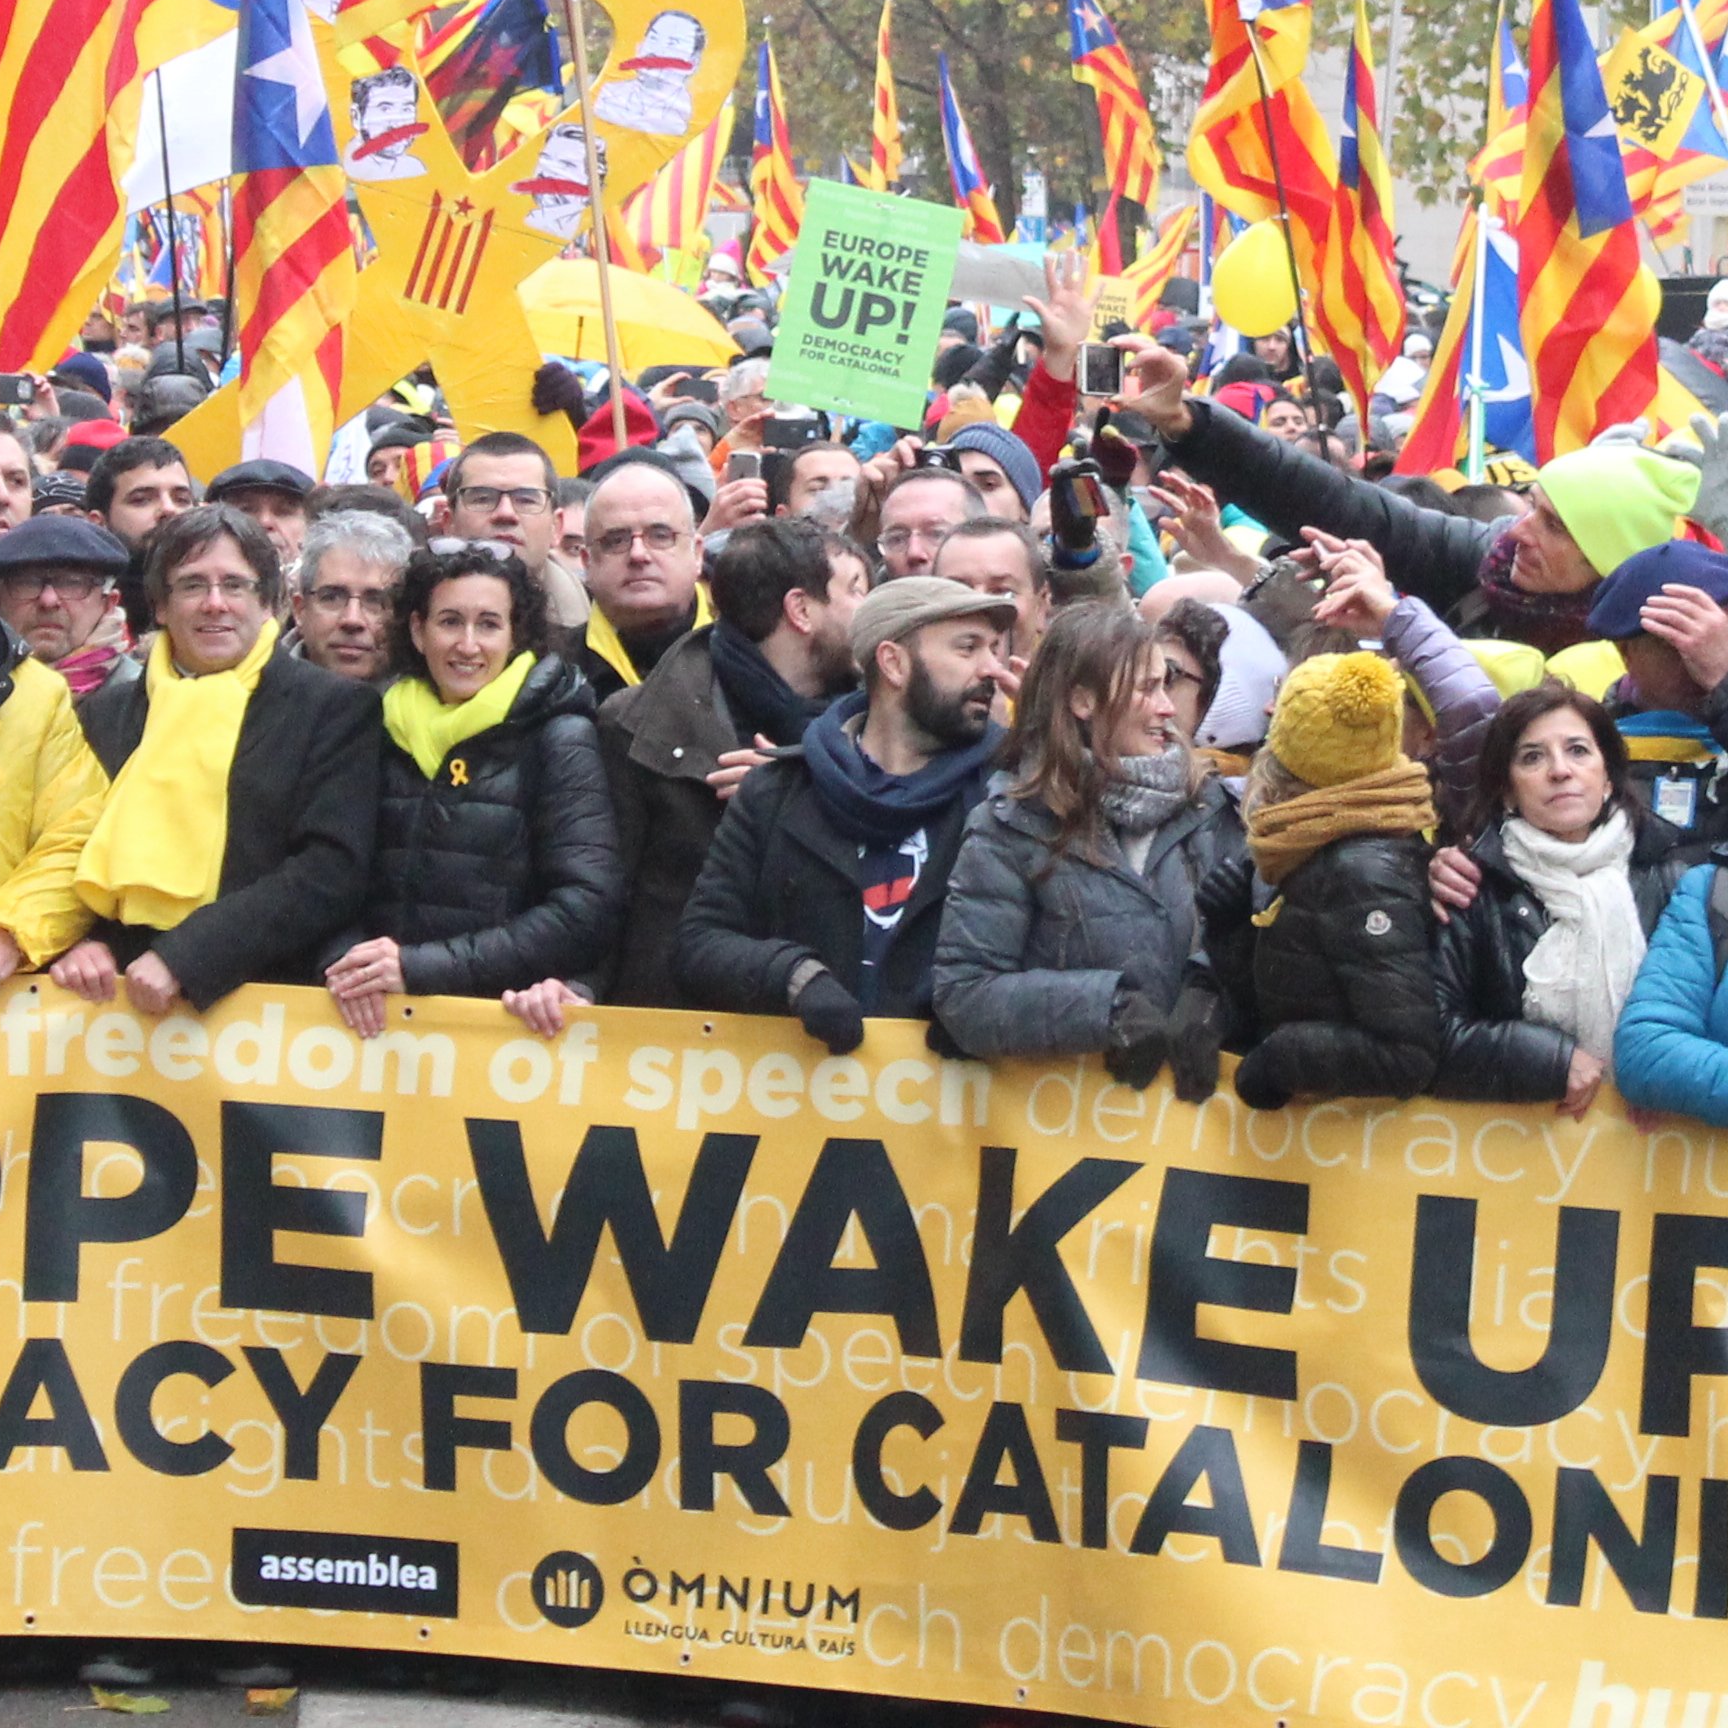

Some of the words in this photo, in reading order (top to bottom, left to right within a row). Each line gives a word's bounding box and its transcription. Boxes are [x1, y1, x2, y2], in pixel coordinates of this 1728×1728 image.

[821, 253, 924, 297] WAKE
[824, 229, 930, 269] EUROPE
[809, 280, 917, 346] UP!
[802, 333, 905, 366] DEMOCRACY
[828, 350, 902, 378] CATALONIA
[0, 991, 457, 1099] freedom
[487, 1021, 600, 1106] of
[464, 1117, 1310, 1402] WAKE
[419, 1361, 792, 1519] FOR
[260, 1552, 439, 1592] assemblea
[622, 1555, 861, 1624] ÒMNIUM
[624, 1619, 710, 1643] LLENGUA
[720, 1629, 807, 1651] CULTURA
[818, 1636, 856, 1656] PAÍS
[999, 1594, 1549, 1728] democracy
